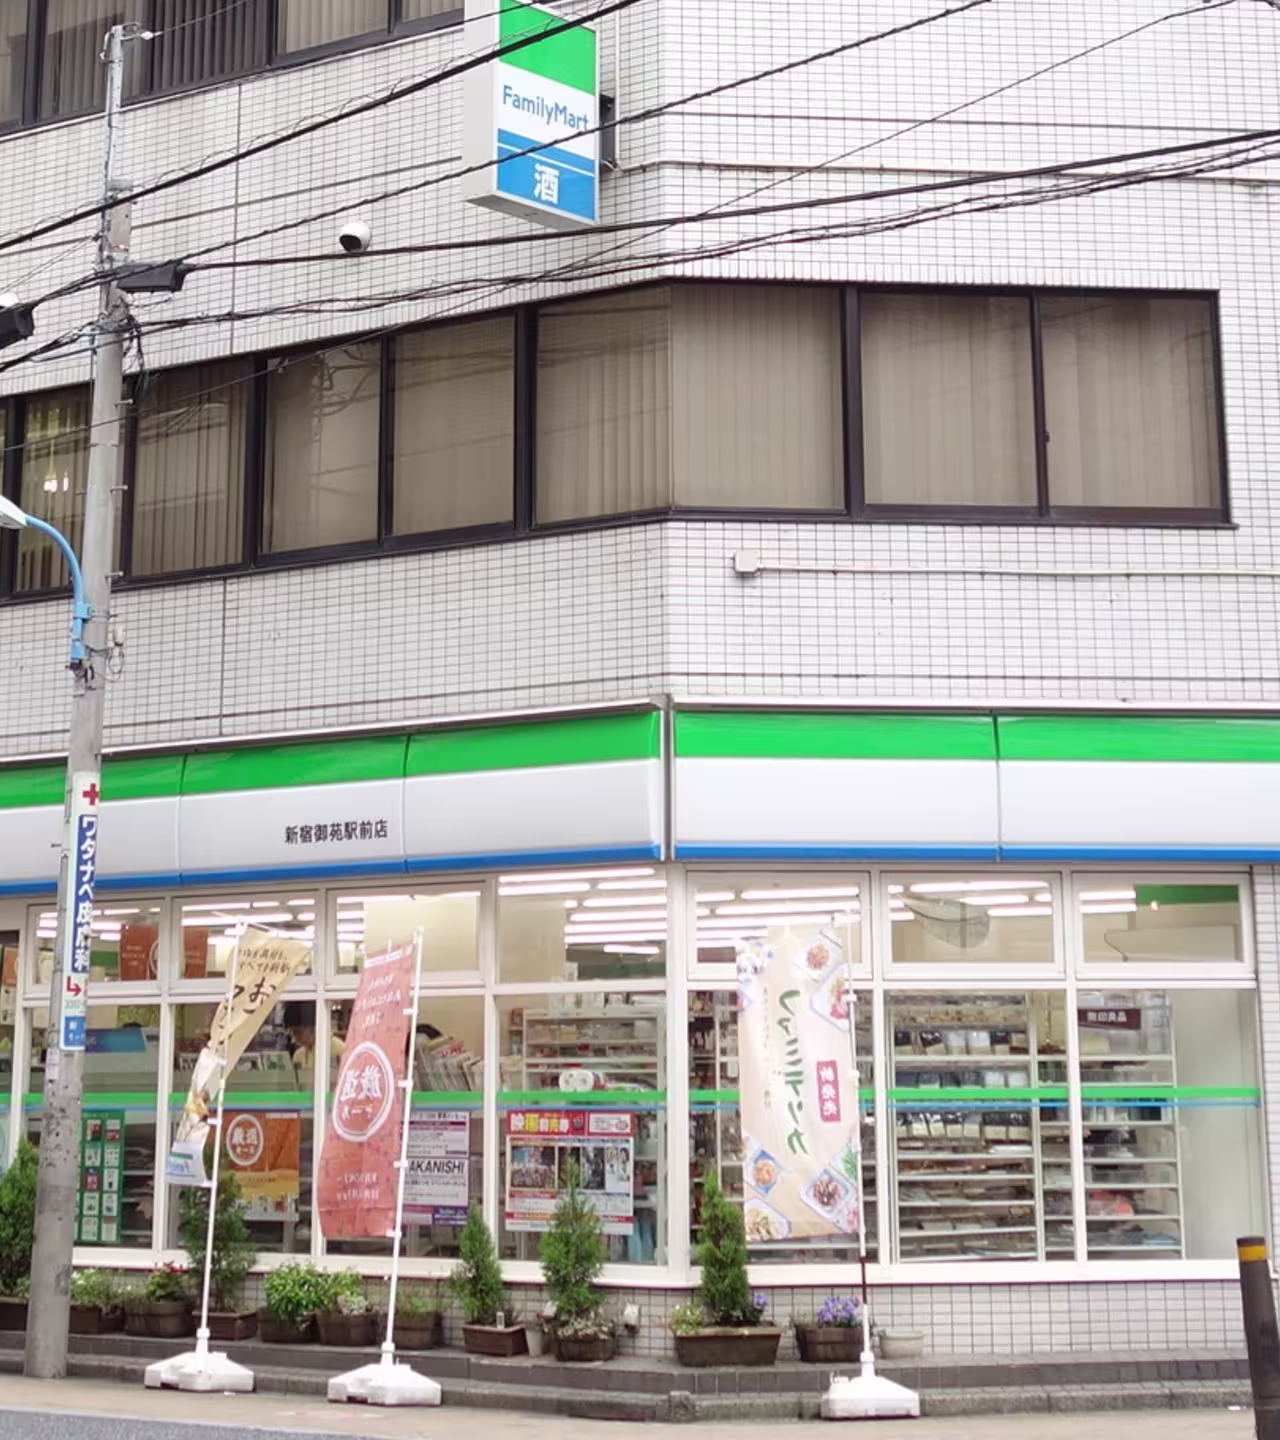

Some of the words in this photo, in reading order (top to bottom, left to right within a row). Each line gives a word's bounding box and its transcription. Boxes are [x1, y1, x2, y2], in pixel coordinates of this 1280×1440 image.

[503, 85, 589, 131] FamilyMart
[533, 162, 560, 205] 酒
[284, 818, 388, 844] 新宿御苑駅前店
[409, 1160, 464, 1175] AKANISHI
